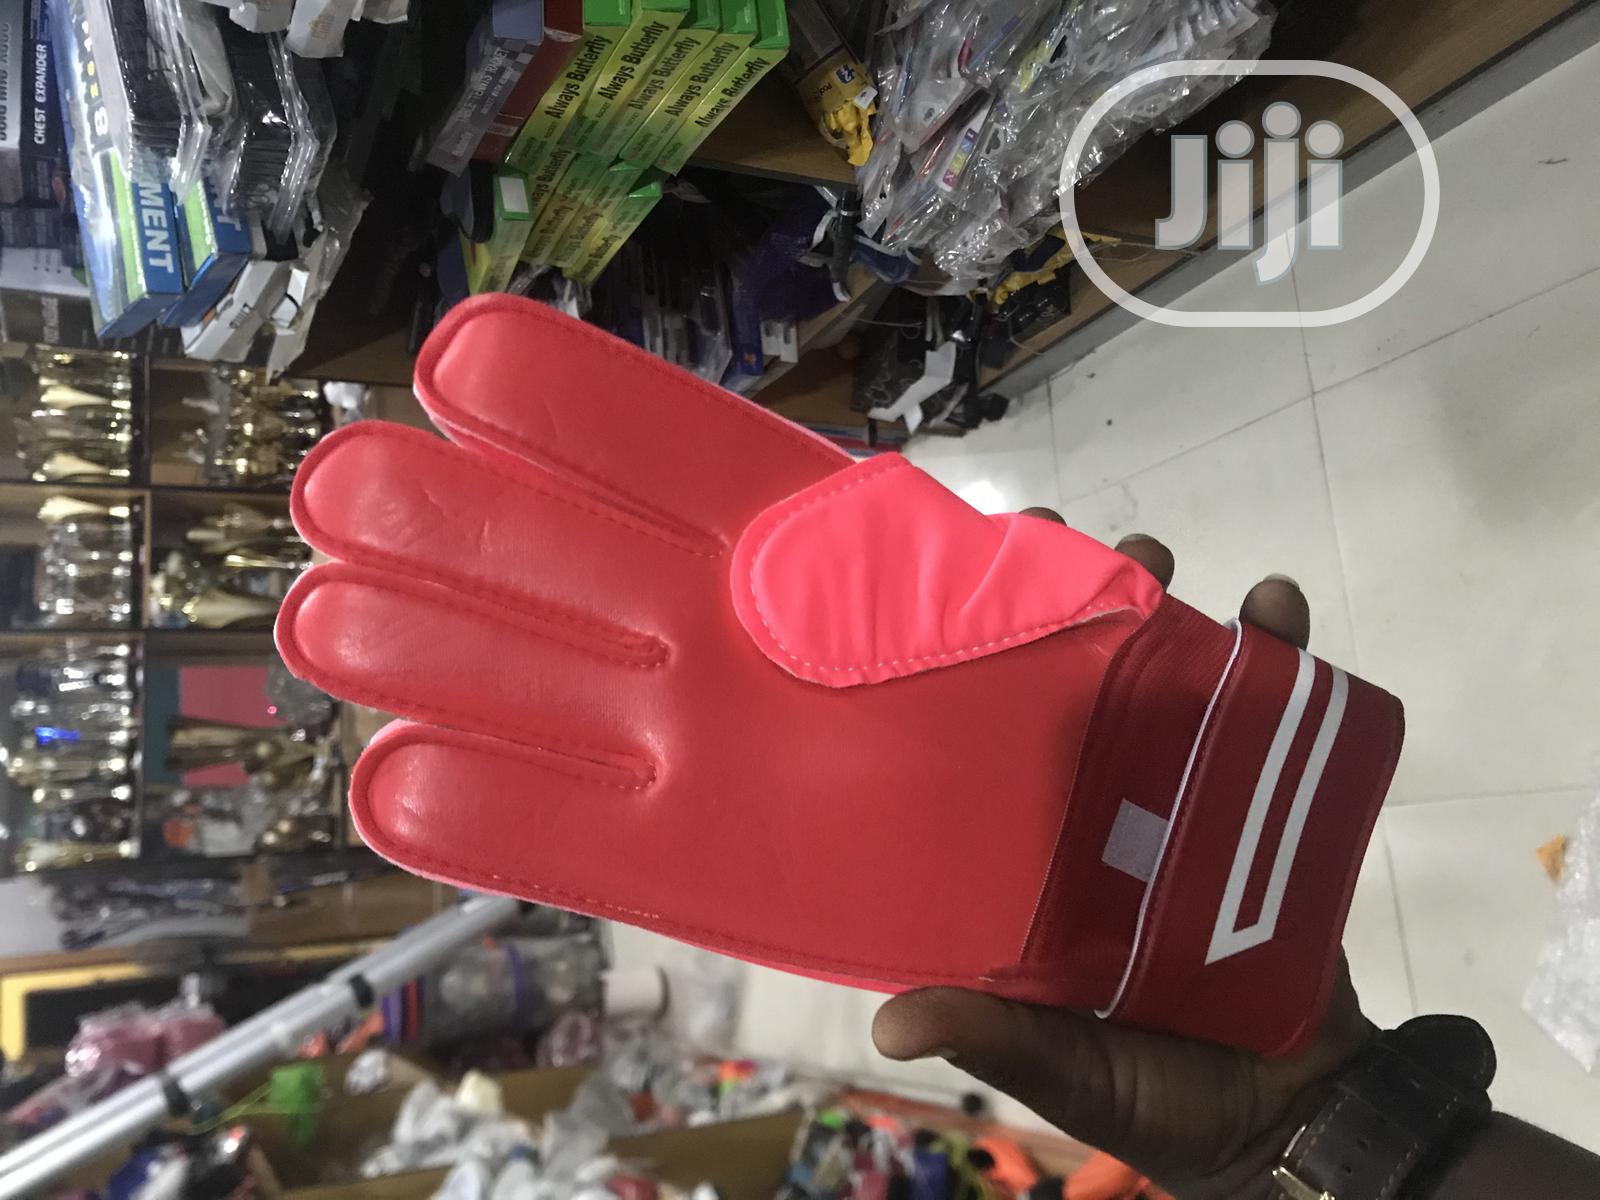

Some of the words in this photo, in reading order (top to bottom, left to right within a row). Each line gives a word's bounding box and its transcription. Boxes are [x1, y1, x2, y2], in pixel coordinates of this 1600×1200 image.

[35, 43, 47, 103] EXPANDER
[544, 82, 580, 119] Always
[566, 35, 613, 82] Butterfly
[597, 65, 635, 101] Always
[621, 21, 670, 65] Butterfly
[627, 79, 665, 111] Always
[652, 37, 702, 78] Butterfly
[665, 84, 702, 117] Always
[689, 41, 740, 83] Butterfly
[694, 97, 730, 128] Always
[721, 57, 771, 97] Butterfly
[34, 107, 46, 145] CHEST
